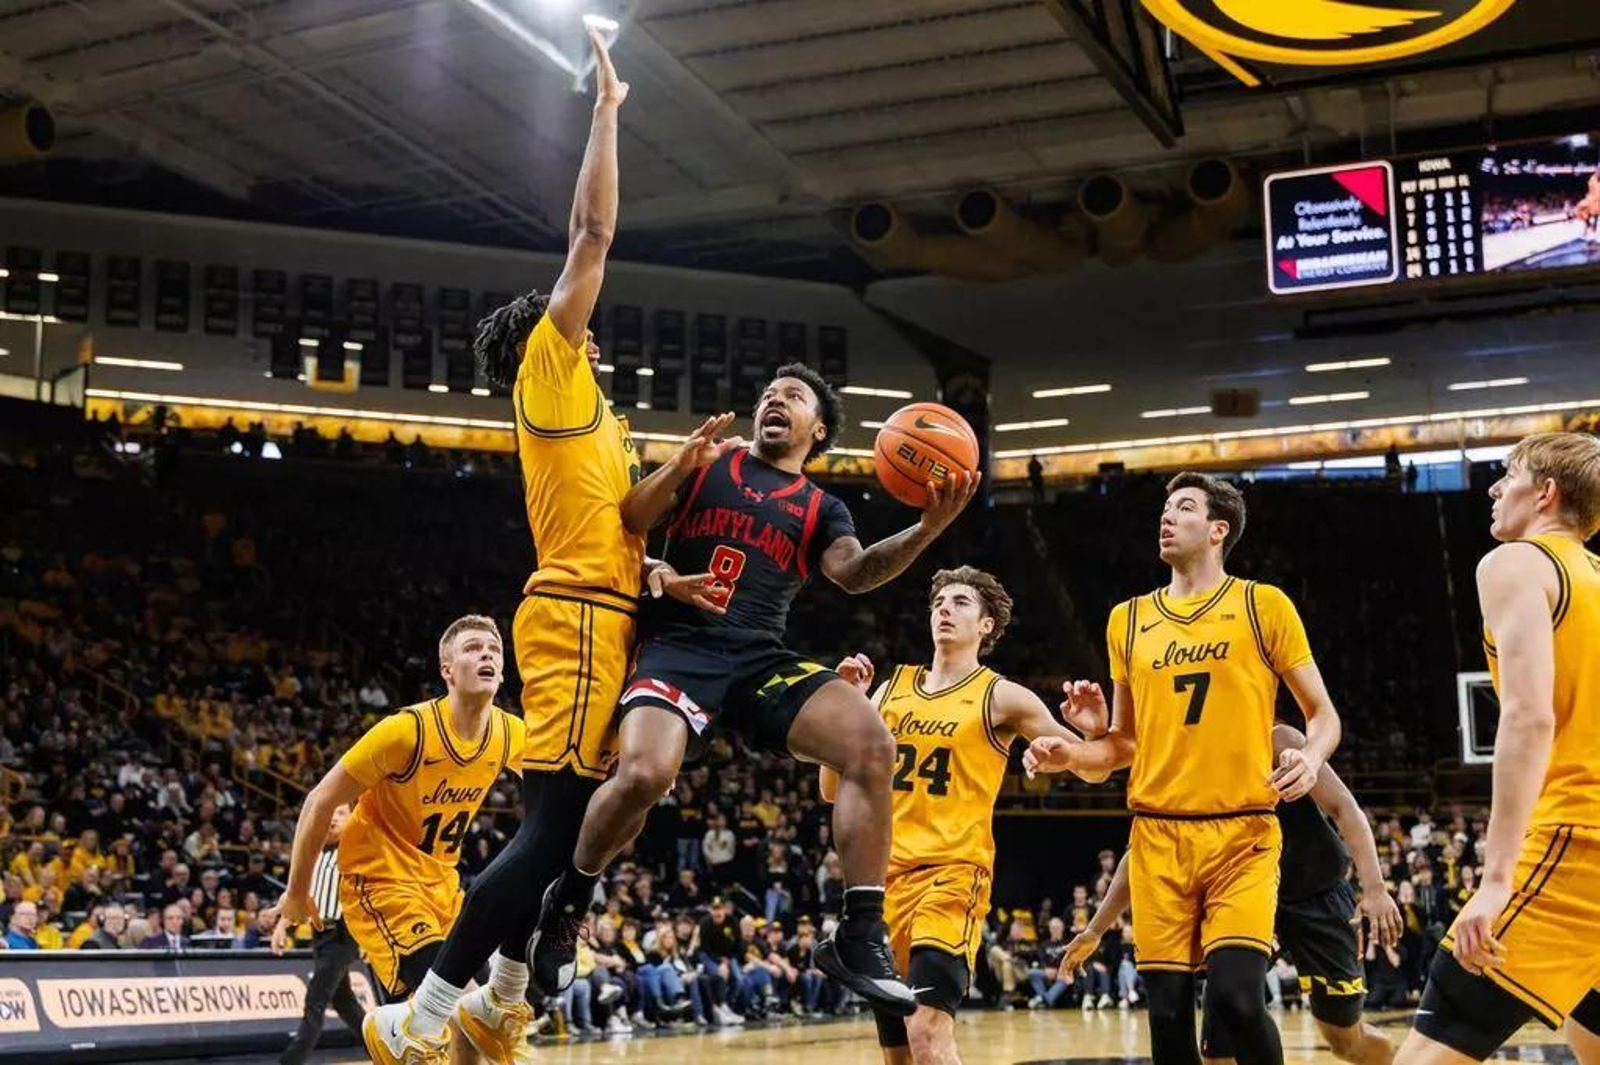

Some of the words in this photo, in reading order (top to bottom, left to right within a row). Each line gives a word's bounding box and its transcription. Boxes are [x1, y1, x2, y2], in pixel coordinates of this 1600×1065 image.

[1418, 158, 1452, 173] IOWA
[1444, 191, 1454, 207] 1
[1460, 189, 1470, 205] 1
[1445, 207, 1456, 223] 1
[1276, 235, 1295, 250] At
[1295, 232, 1330, 248] Your
[1446, 224, 1457, 241] 1
[1447, 241, 1458, 258] 1
[1449, 258, 1459, 275] 1
[1464, 256, 1475, 273] 1
[896, 440, 951, 480] ELITE
[684, 507, 795, 572] MARYLAND
[701, 544, 747, 611] 8
[1151, 640, 1230, 670] Iowa
[1173, 671, 1211, 727] 7
[890, 710, 960, 738] Iowa
[892, 743, 952, 797] 24
[421, 778, 484, 805] Iowa
[417, 810, 471, 855] 14
[58, 985, 298, 1019] IOWASNEWSNOW.com
